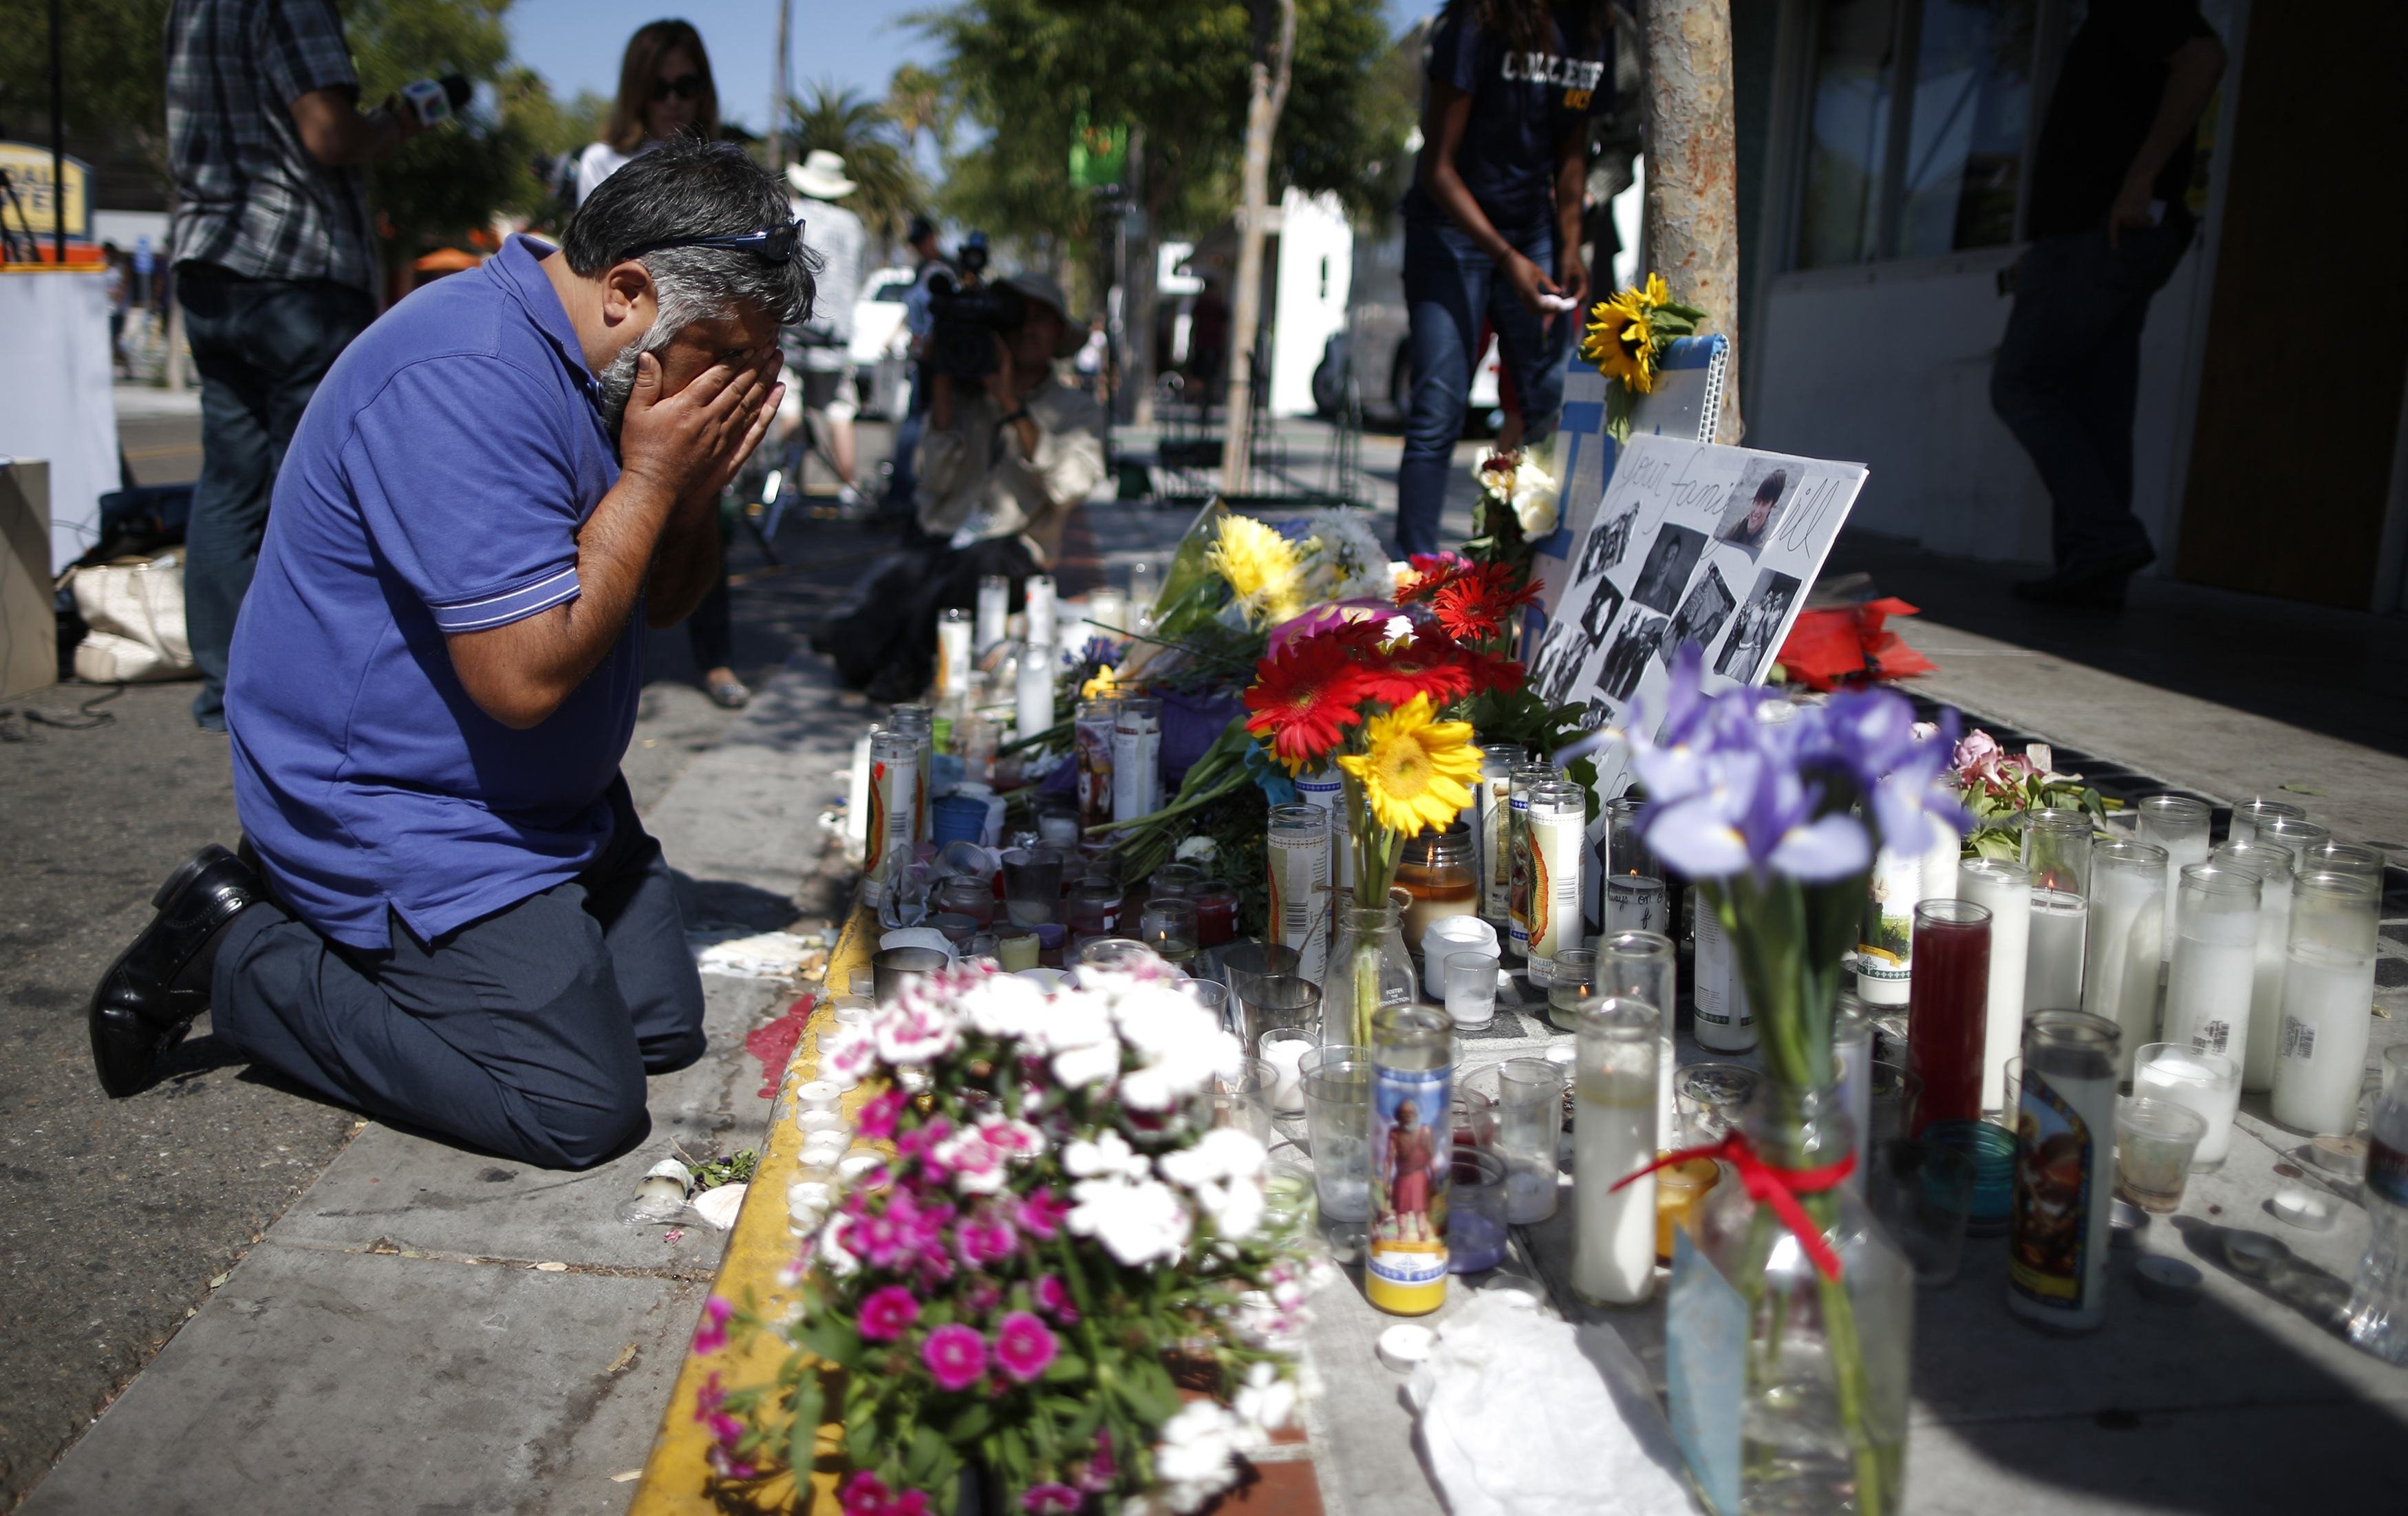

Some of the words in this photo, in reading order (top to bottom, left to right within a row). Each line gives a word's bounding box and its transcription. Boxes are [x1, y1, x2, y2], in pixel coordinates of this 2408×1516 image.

[1643, 447, 1728, 537] fami
[1770, 478, 1840, 559] ill
[1609, 894, 1628, 912] ways
[1379, 996, 1410, 1007] CONNECTION
